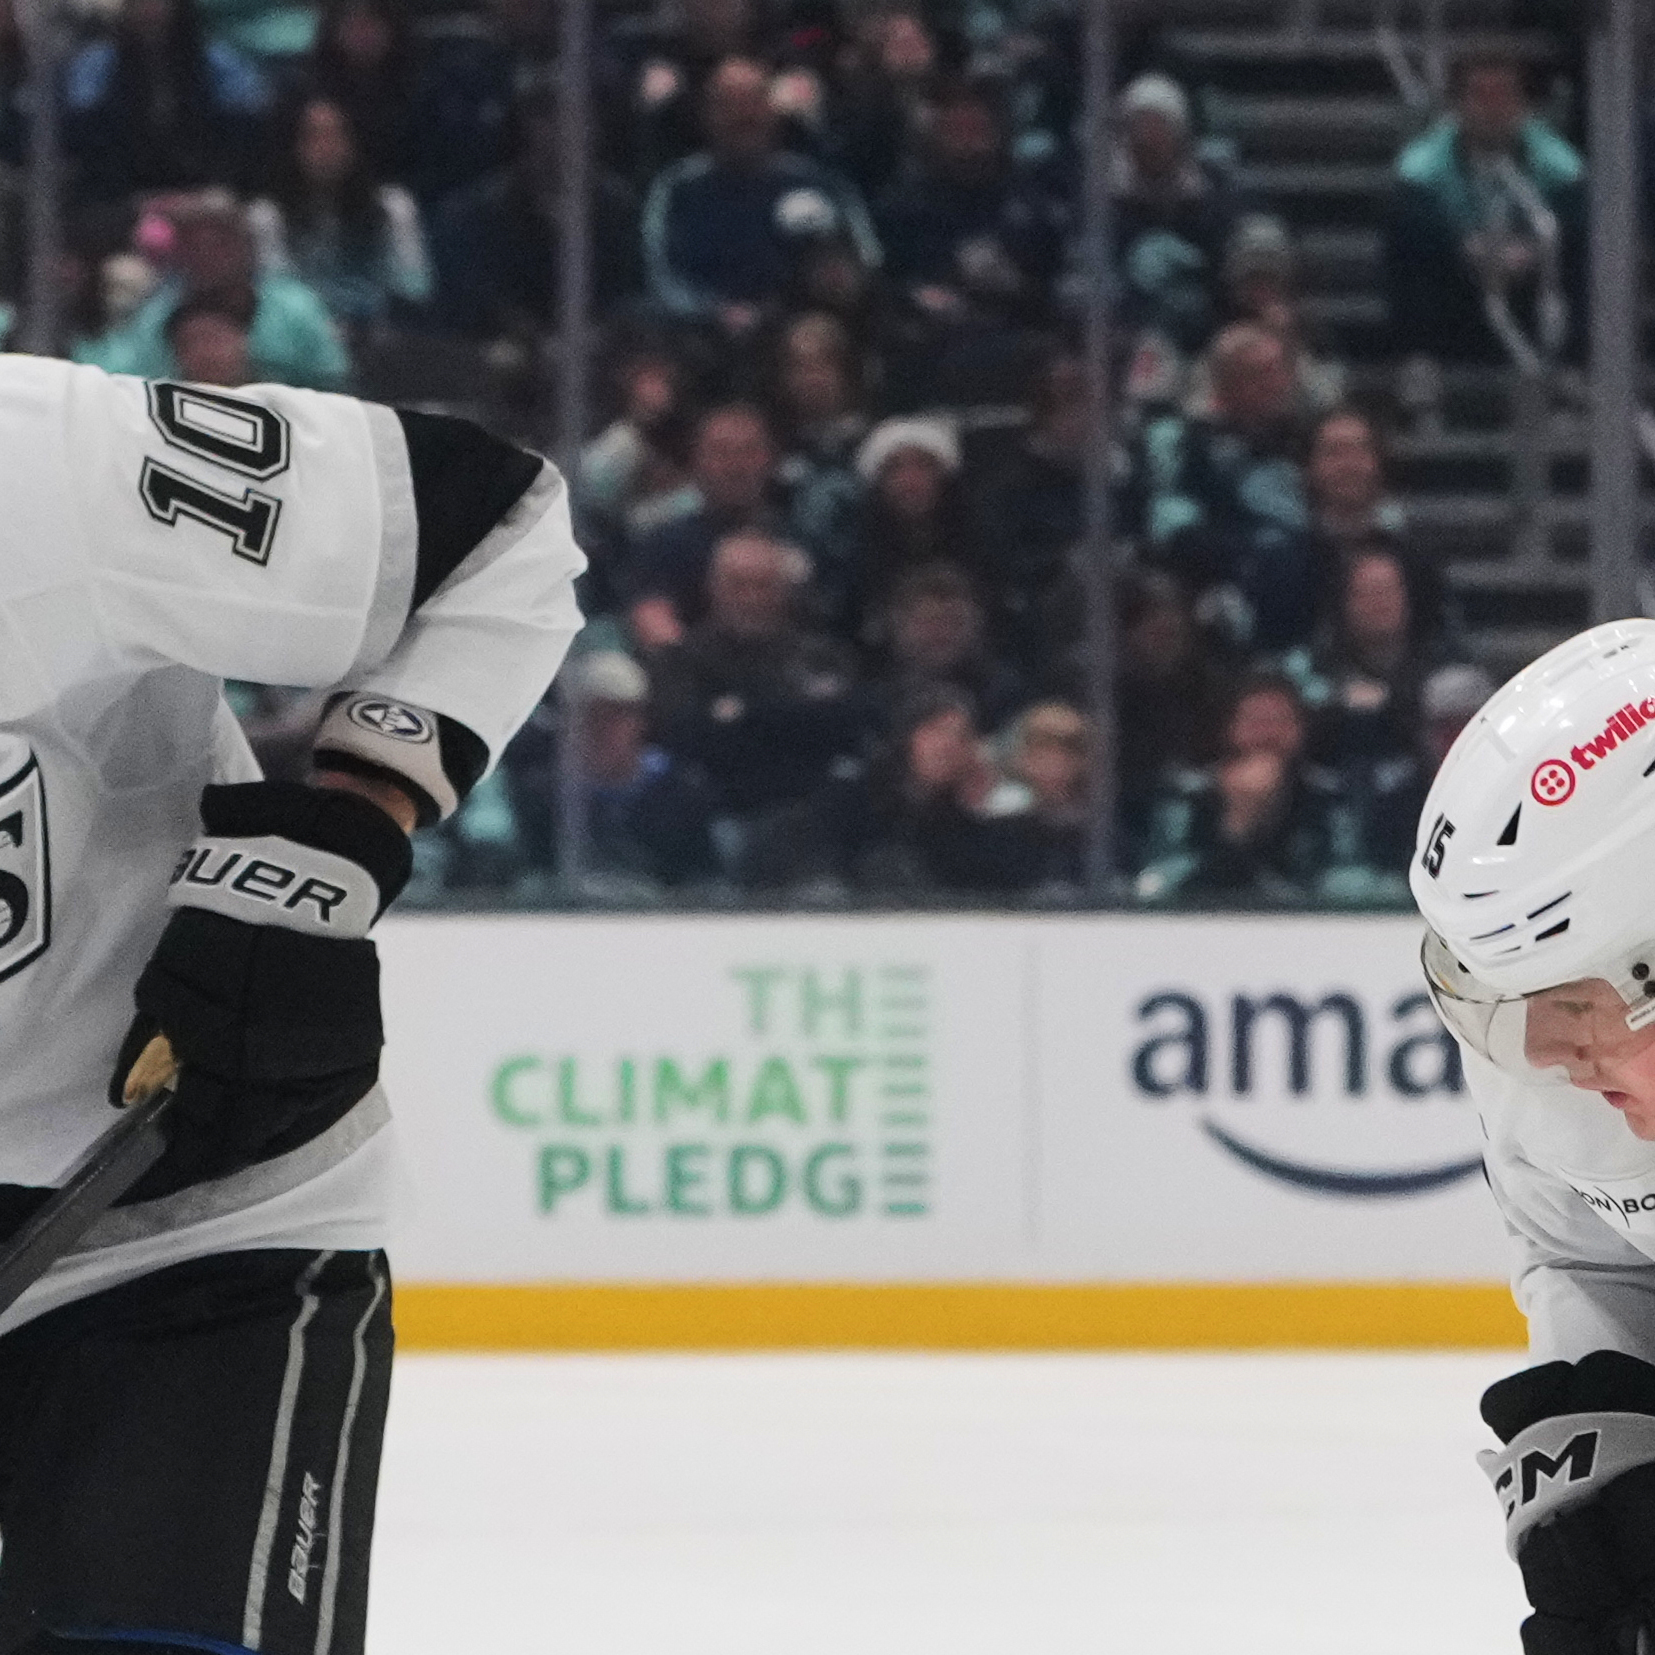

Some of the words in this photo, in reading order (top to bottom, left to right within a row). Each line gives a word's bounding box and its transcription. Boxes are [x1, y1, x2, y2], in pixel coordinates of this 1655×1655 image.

[139, 380, 290, 567] 10
[171, 848, 348, 924] UER
[728, 964, 931, 1041] THE
[1131, 986, 1464, 1100] ama
[489, 1055, 931, 1129] CLIMATE
[536, 1141, 931, 1218] PLEDGE
